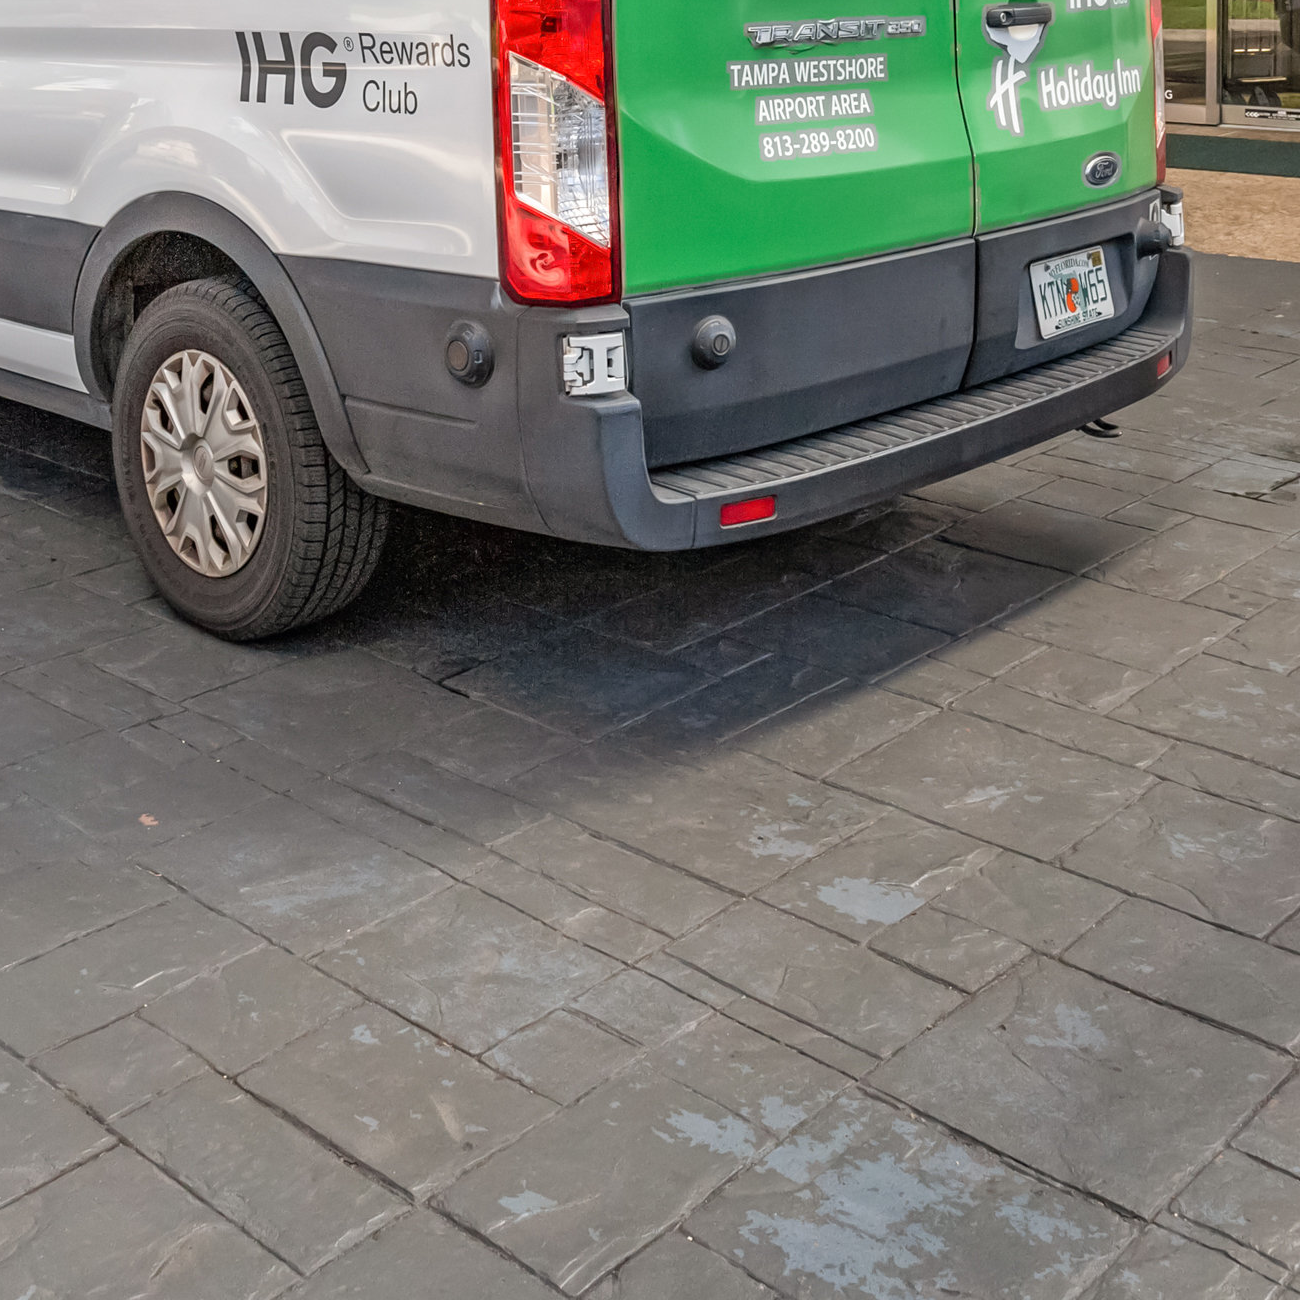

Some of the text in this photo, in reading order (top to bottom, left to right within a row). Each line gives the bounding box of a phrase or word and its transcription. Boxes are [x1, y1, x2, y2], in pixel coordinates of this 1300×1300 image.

[747, 18, 886, 45] TRANSIT
[358, 32, 471, 68] Rewards
[730, 57, 885, 87] TAMPA WESTSHORE
[1040, 58, 1141, 109] Holiday Inn
[362, 80, 418, 115] Club
[758, 93, 871, 122] AIRPORT AREA
[762, 127, 875, 158] 813-289-8200
